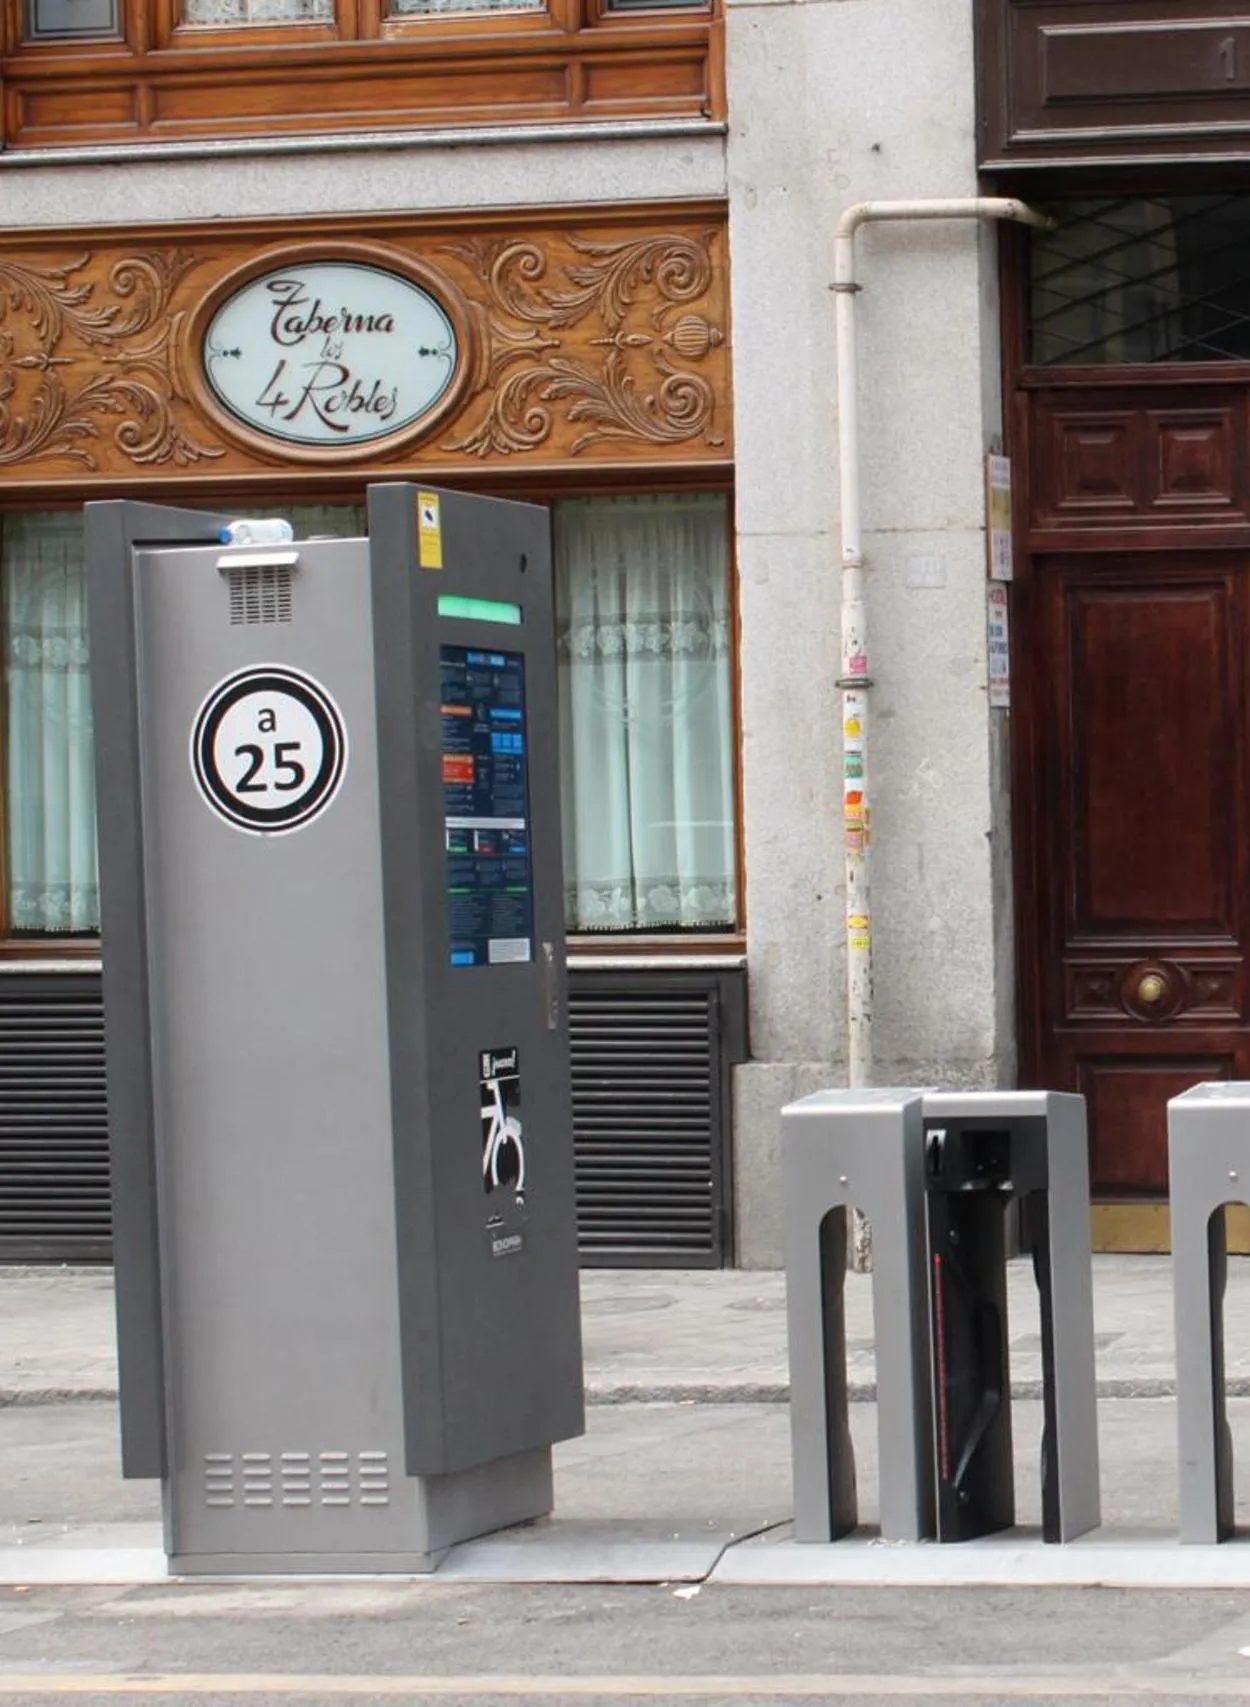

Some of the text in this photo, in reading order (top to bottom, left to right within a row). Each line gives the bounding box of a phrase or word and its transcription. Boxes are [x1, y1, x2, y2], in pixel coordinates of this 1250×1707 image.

[267, 280, 395, 346] Taberna
[255, 359, 399, 432] 4 Robles
[257, 708, 276, 733] a
[234, 742, 306, 792] 25
